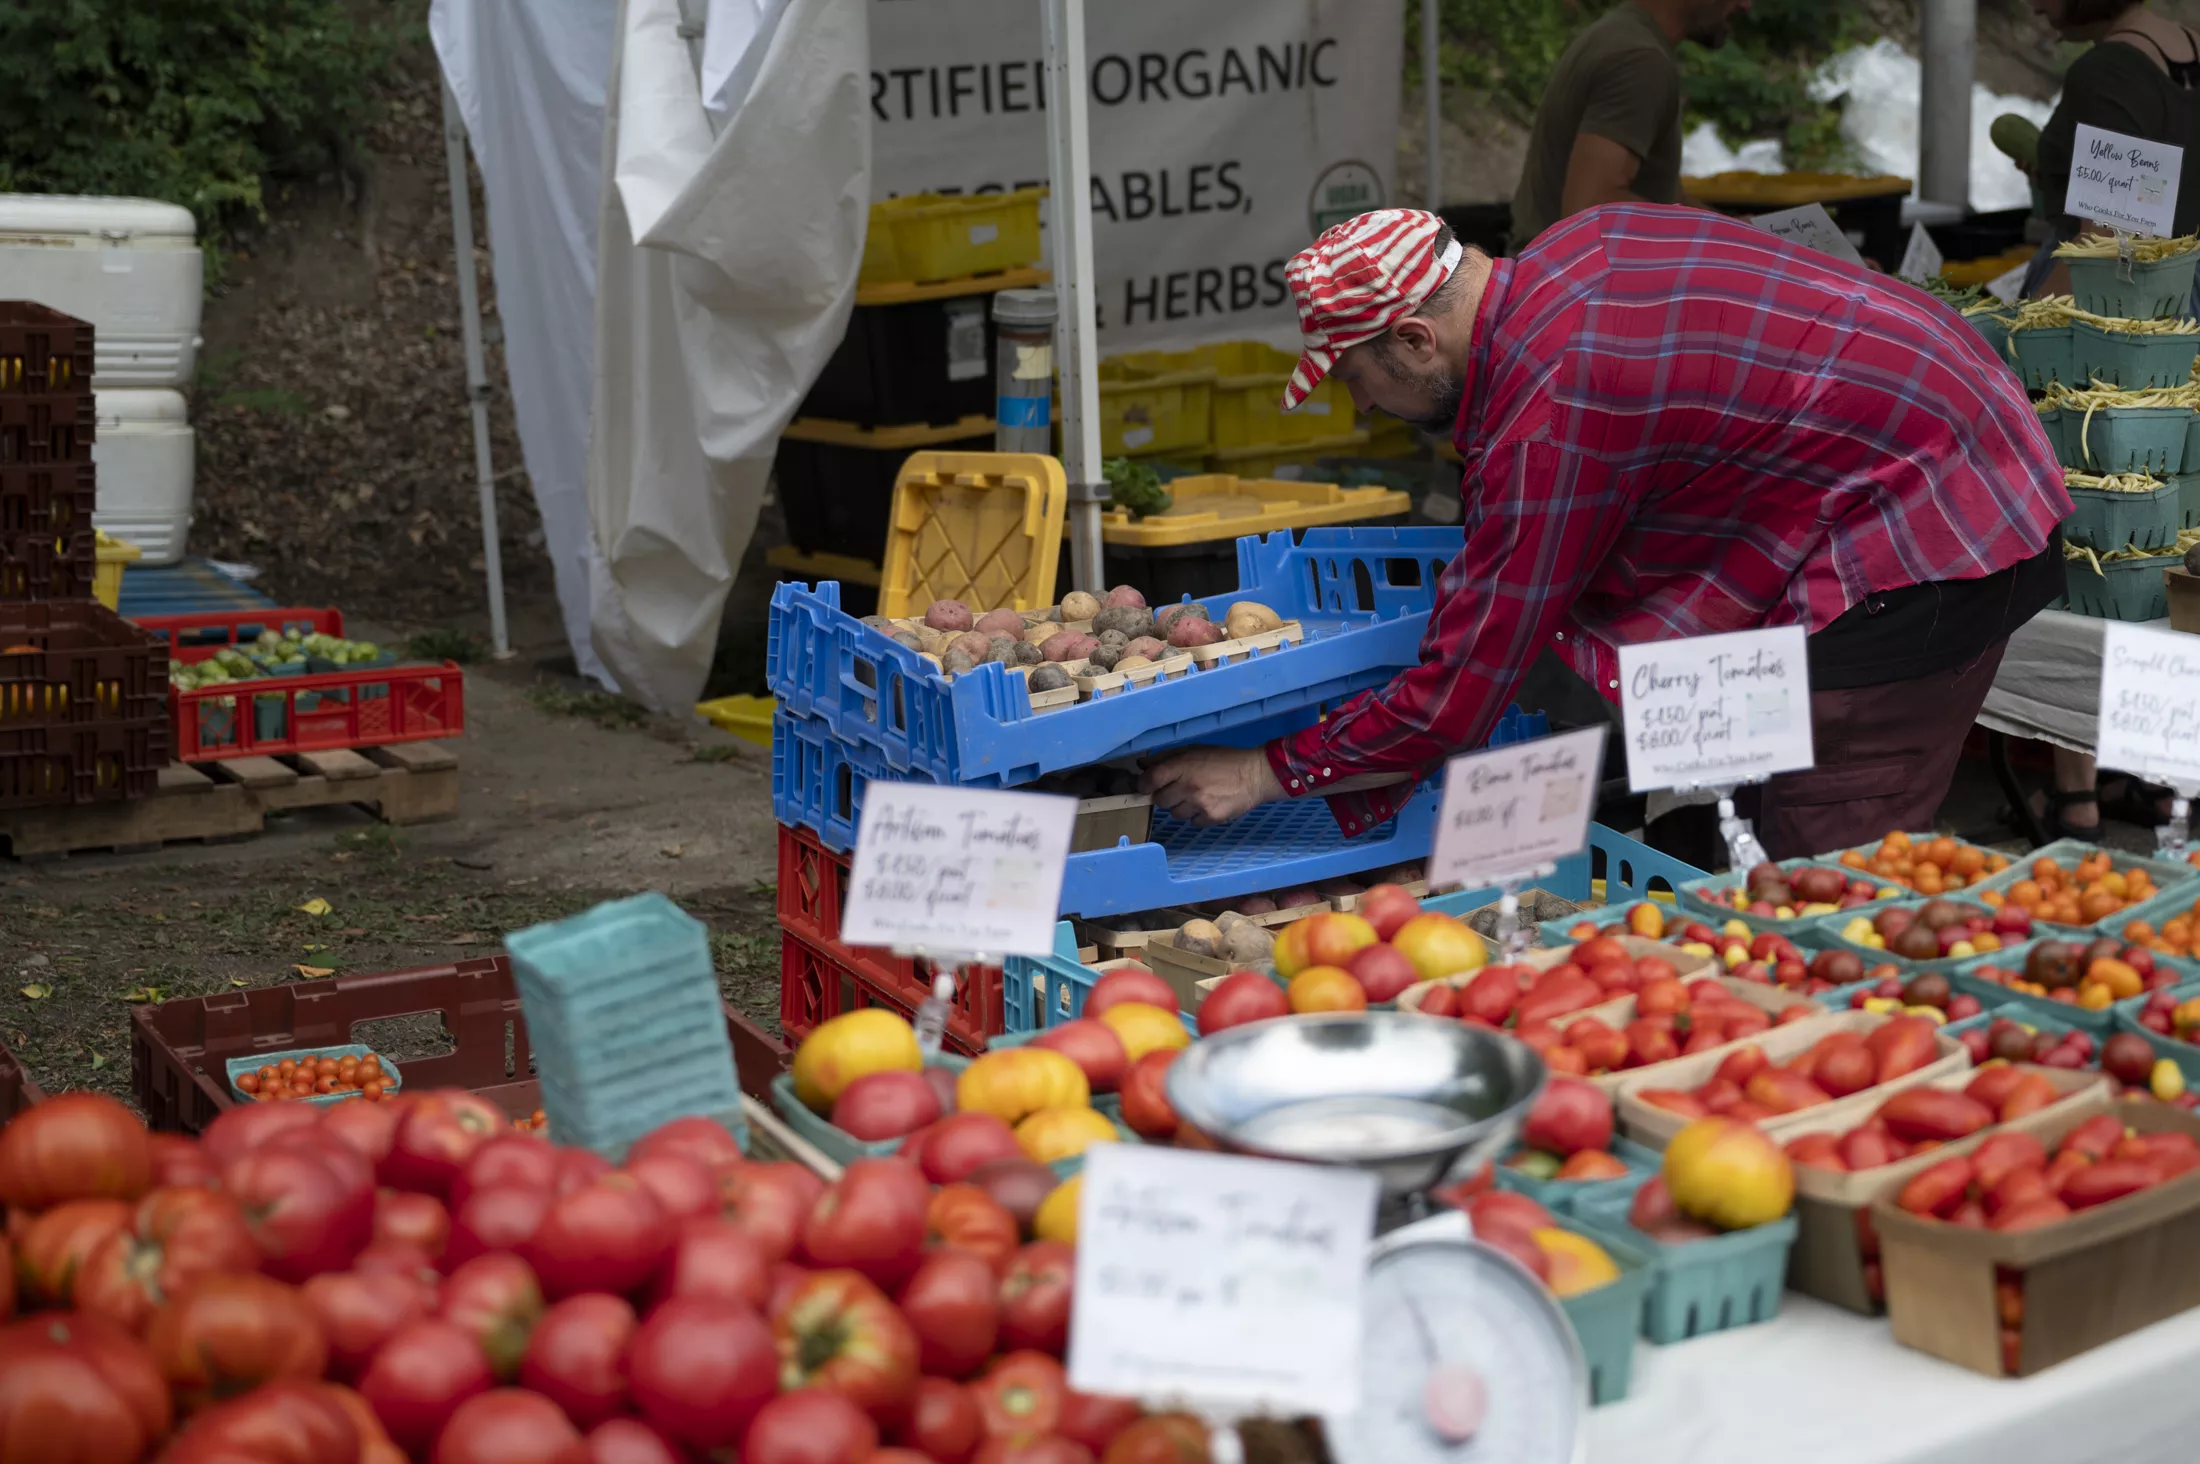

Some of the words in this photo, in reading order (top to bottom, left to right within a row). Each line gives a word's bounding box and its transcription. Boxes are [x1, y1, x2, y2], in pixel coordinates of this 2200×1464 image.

[870, 58, 1047, 122] RTIFIE
[1091, 38, 1339, 105] ORGANIC
[2090, 139, 2124, 160] Yellow
[2127, 149, 2160, 172] Beans
[2078, 200, 2093, 211] Who
[2093, 205, 2113, 216] Cooks
[2114, 210, 2125, 219] For
[2126, 213, 2139, 223] You
[2140, 217, 2157, 227] Farm
[1124, 258, 1288, 326] HERBS
[1631, 660, 1701, 700] Cherry
[1708, 648, 1787, 687] Tomatoes
